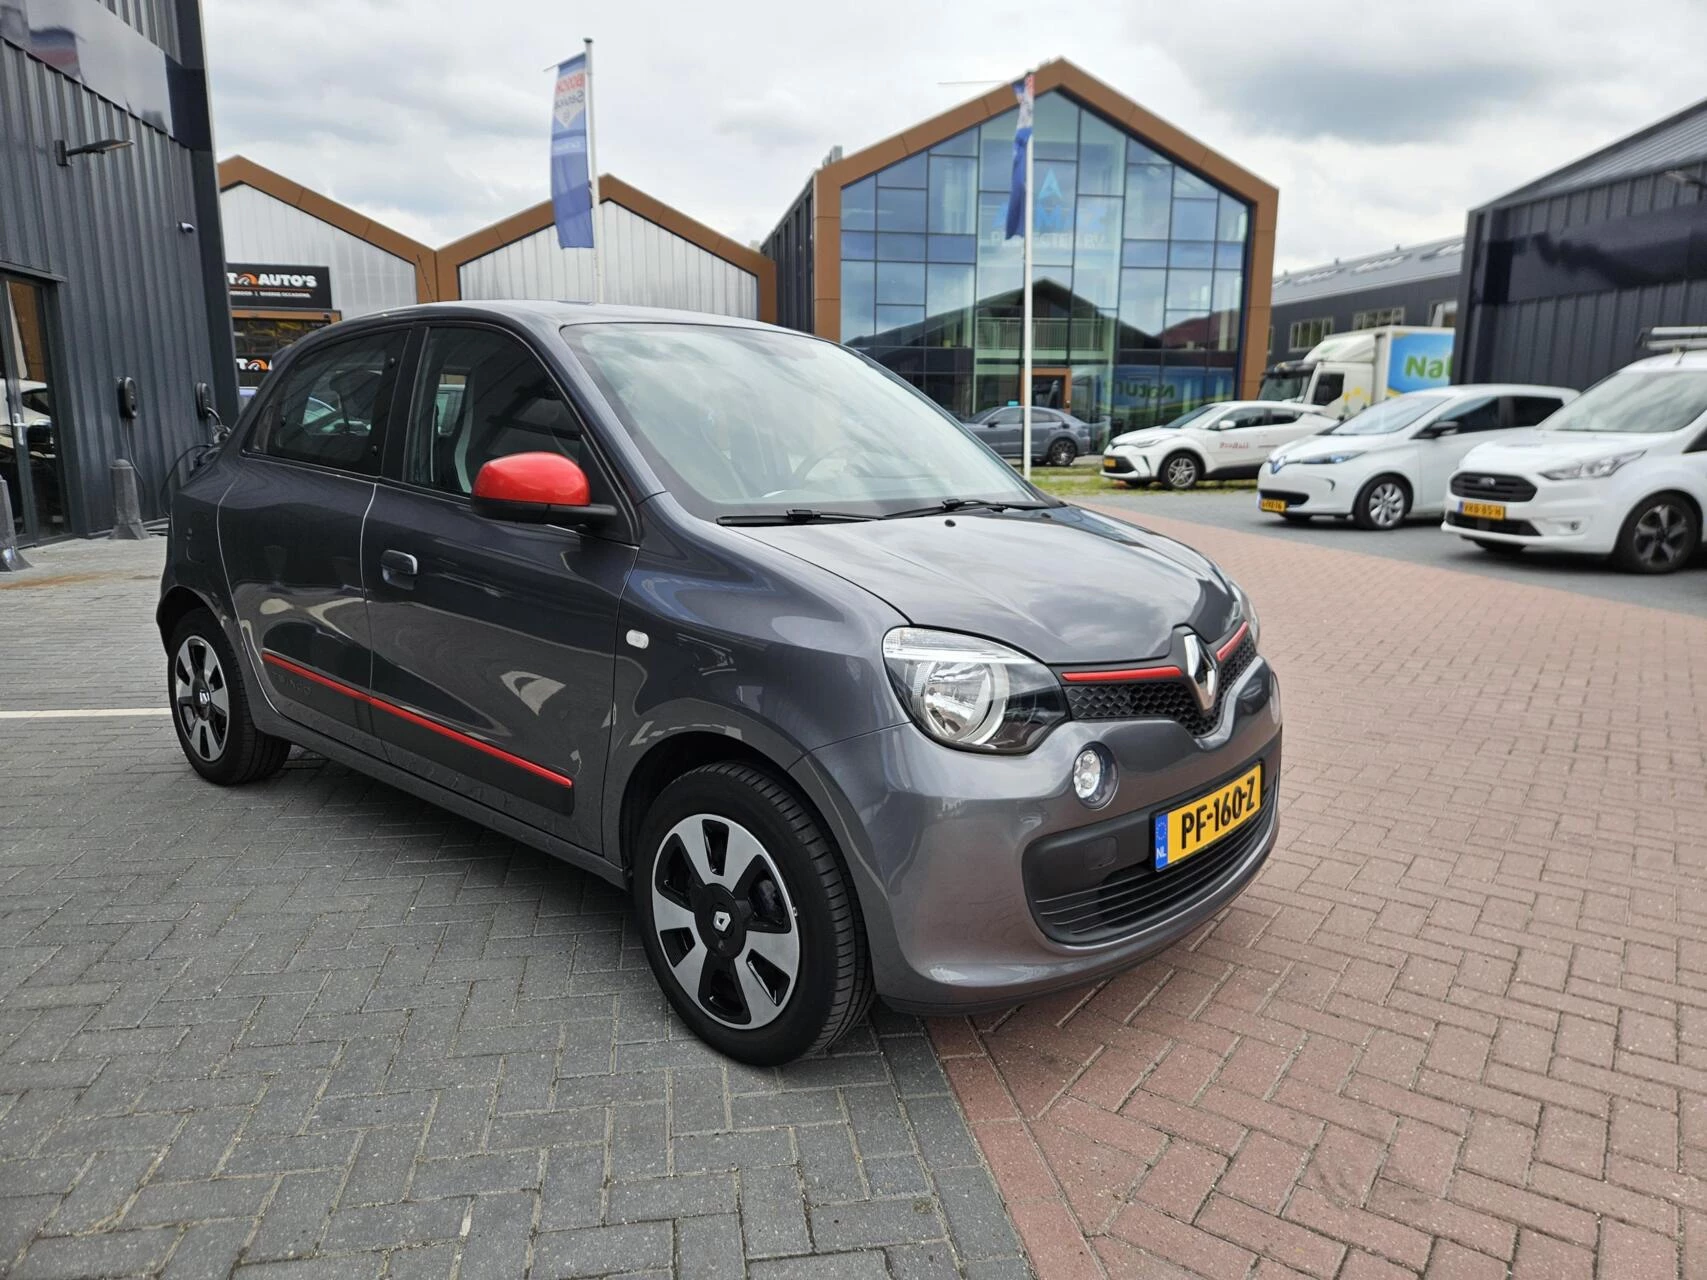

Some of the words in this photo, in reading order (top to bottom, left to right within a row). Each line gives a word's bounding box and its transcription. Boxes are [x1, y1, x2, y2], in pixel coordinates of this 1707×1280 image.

[258, 273, 317, 288] AUTO'S
[1181, 775, 1255, 850] PF-160-Z
[1156, 846, 1167, 860] NL
